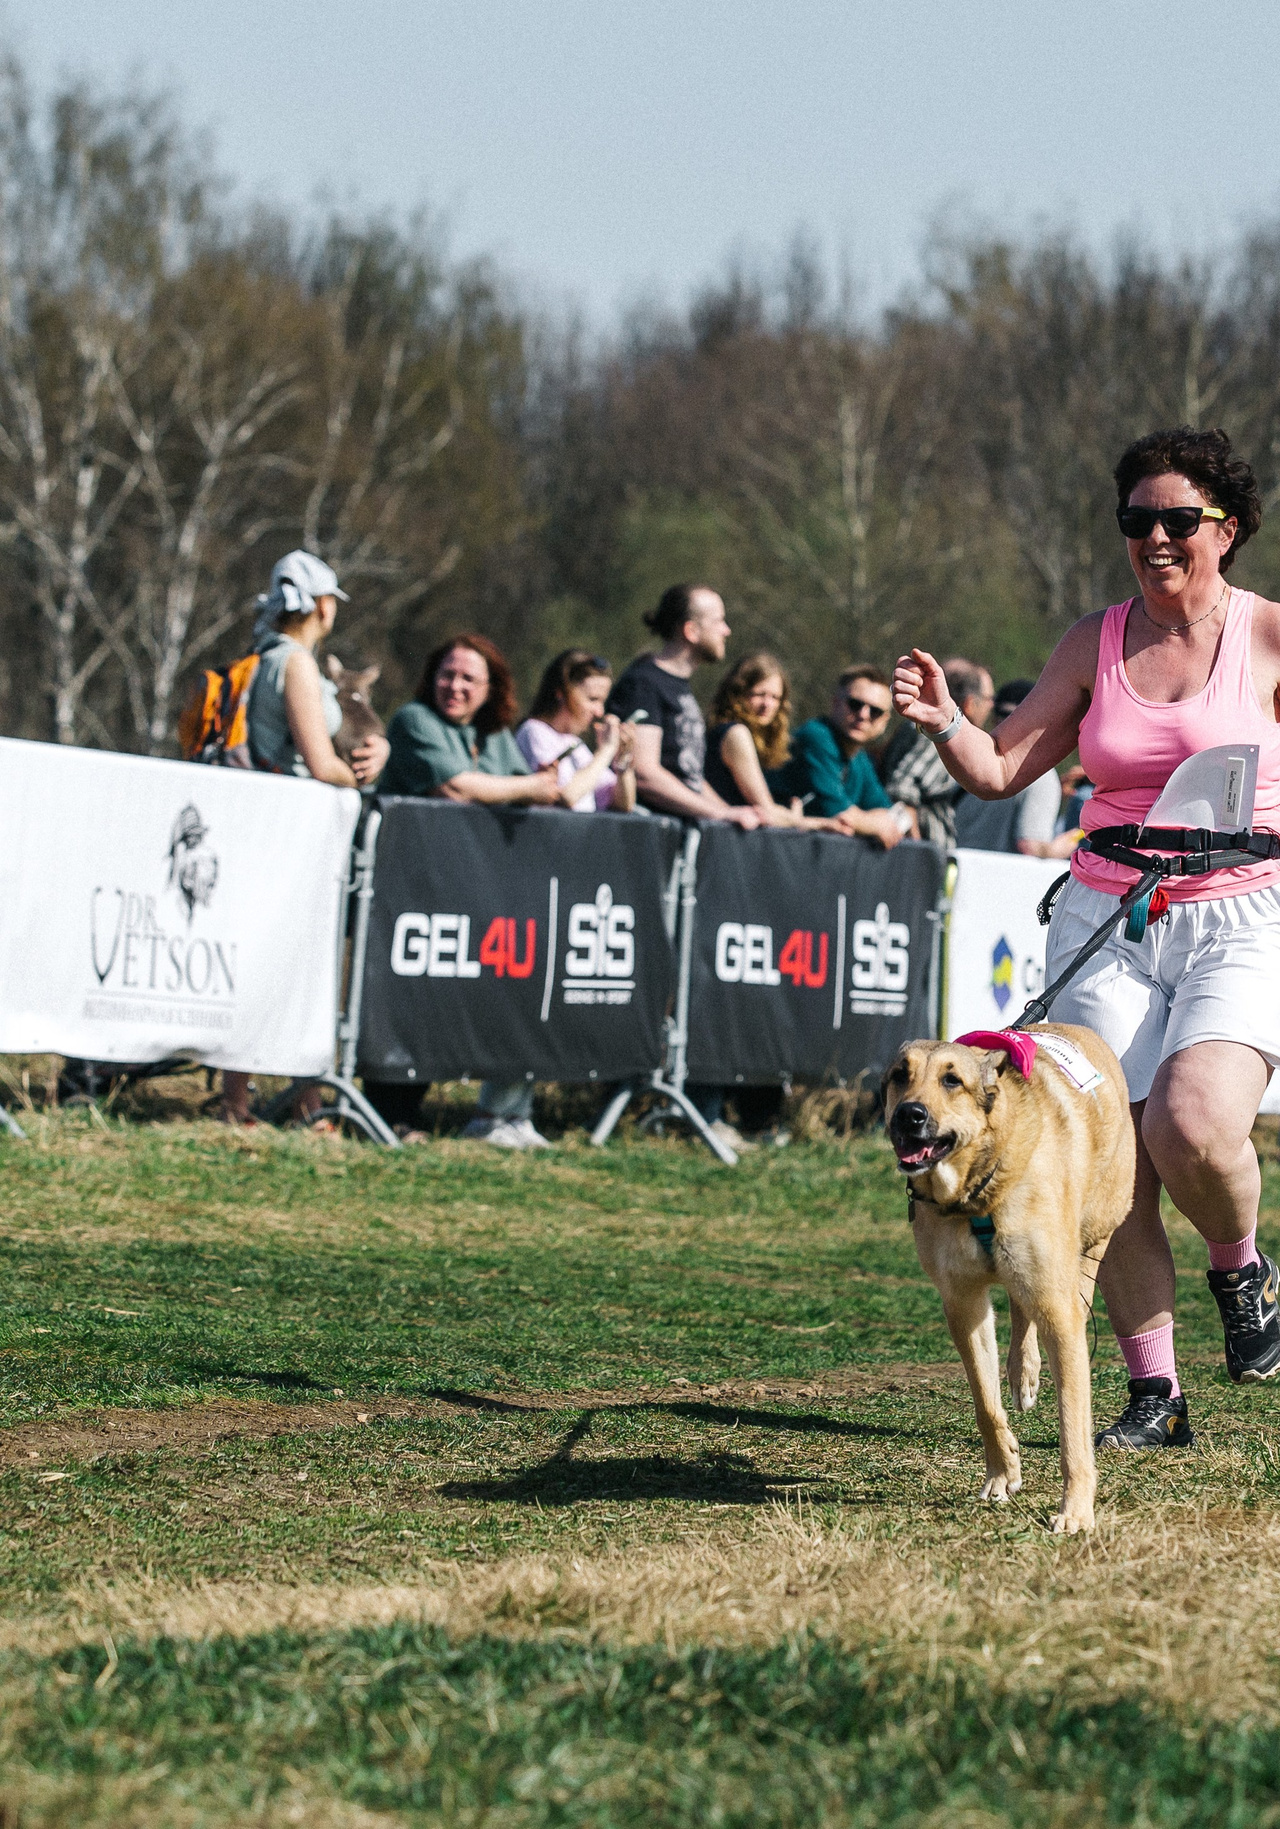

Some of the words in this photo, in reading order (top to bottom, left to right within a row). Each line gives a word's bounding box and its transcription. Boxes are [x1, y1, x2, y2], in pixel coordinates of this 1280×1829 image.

[90, 886, 238, 995] VETSON
[390, 911, 537, 979] GEL4U
[715, 921, 829, 989] GEL4U
